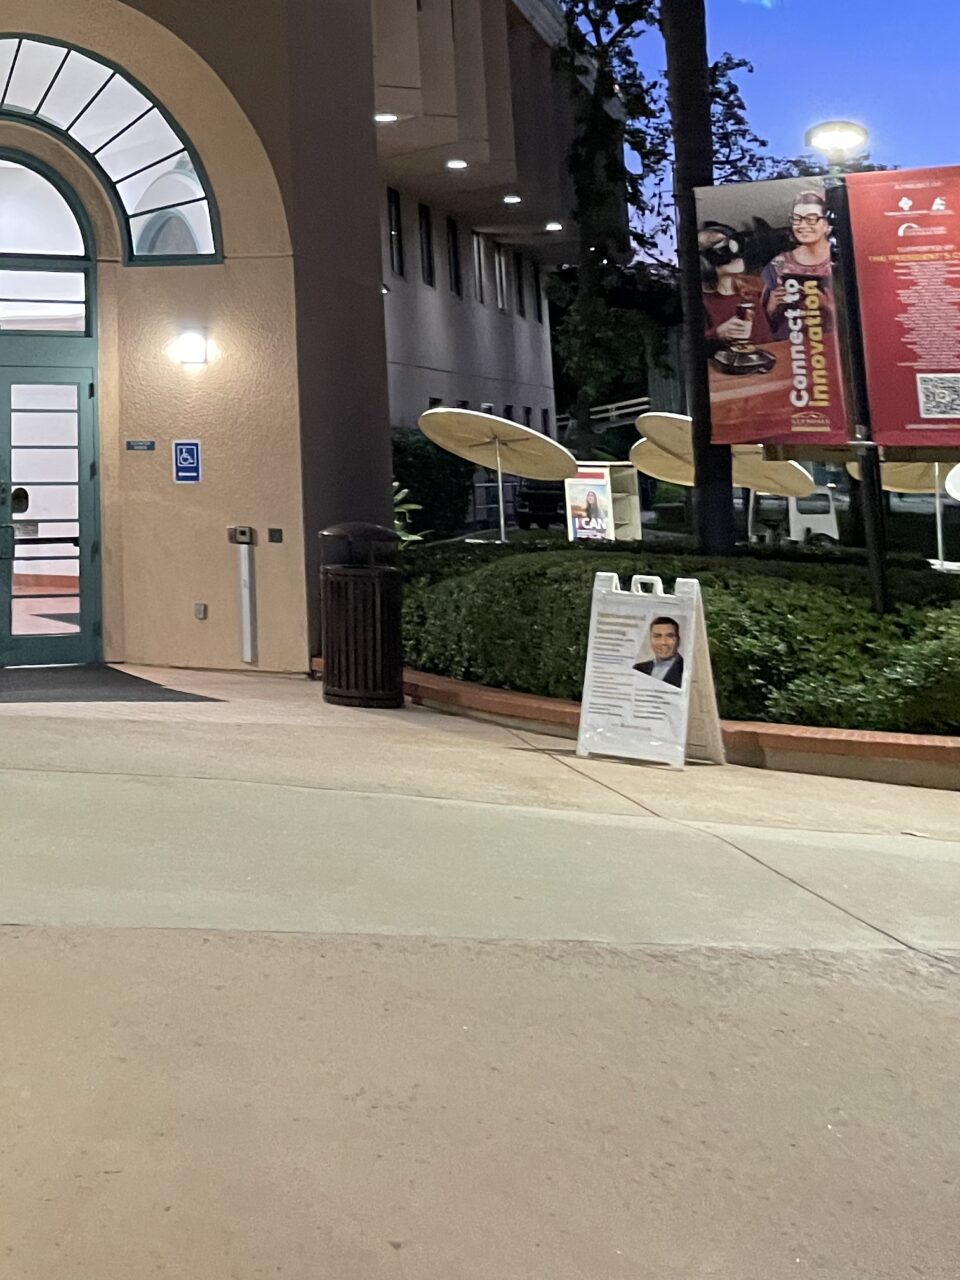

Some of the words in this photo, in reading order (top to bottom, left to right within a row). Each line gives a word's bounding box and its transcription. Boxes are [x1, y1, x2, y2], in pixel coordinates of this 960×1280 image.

[783, 278, 800, 303] to
[784, 308, 809, 408] Connect
[575, 517, 579, 529] I
[581, 517, 607, 530] CAN
